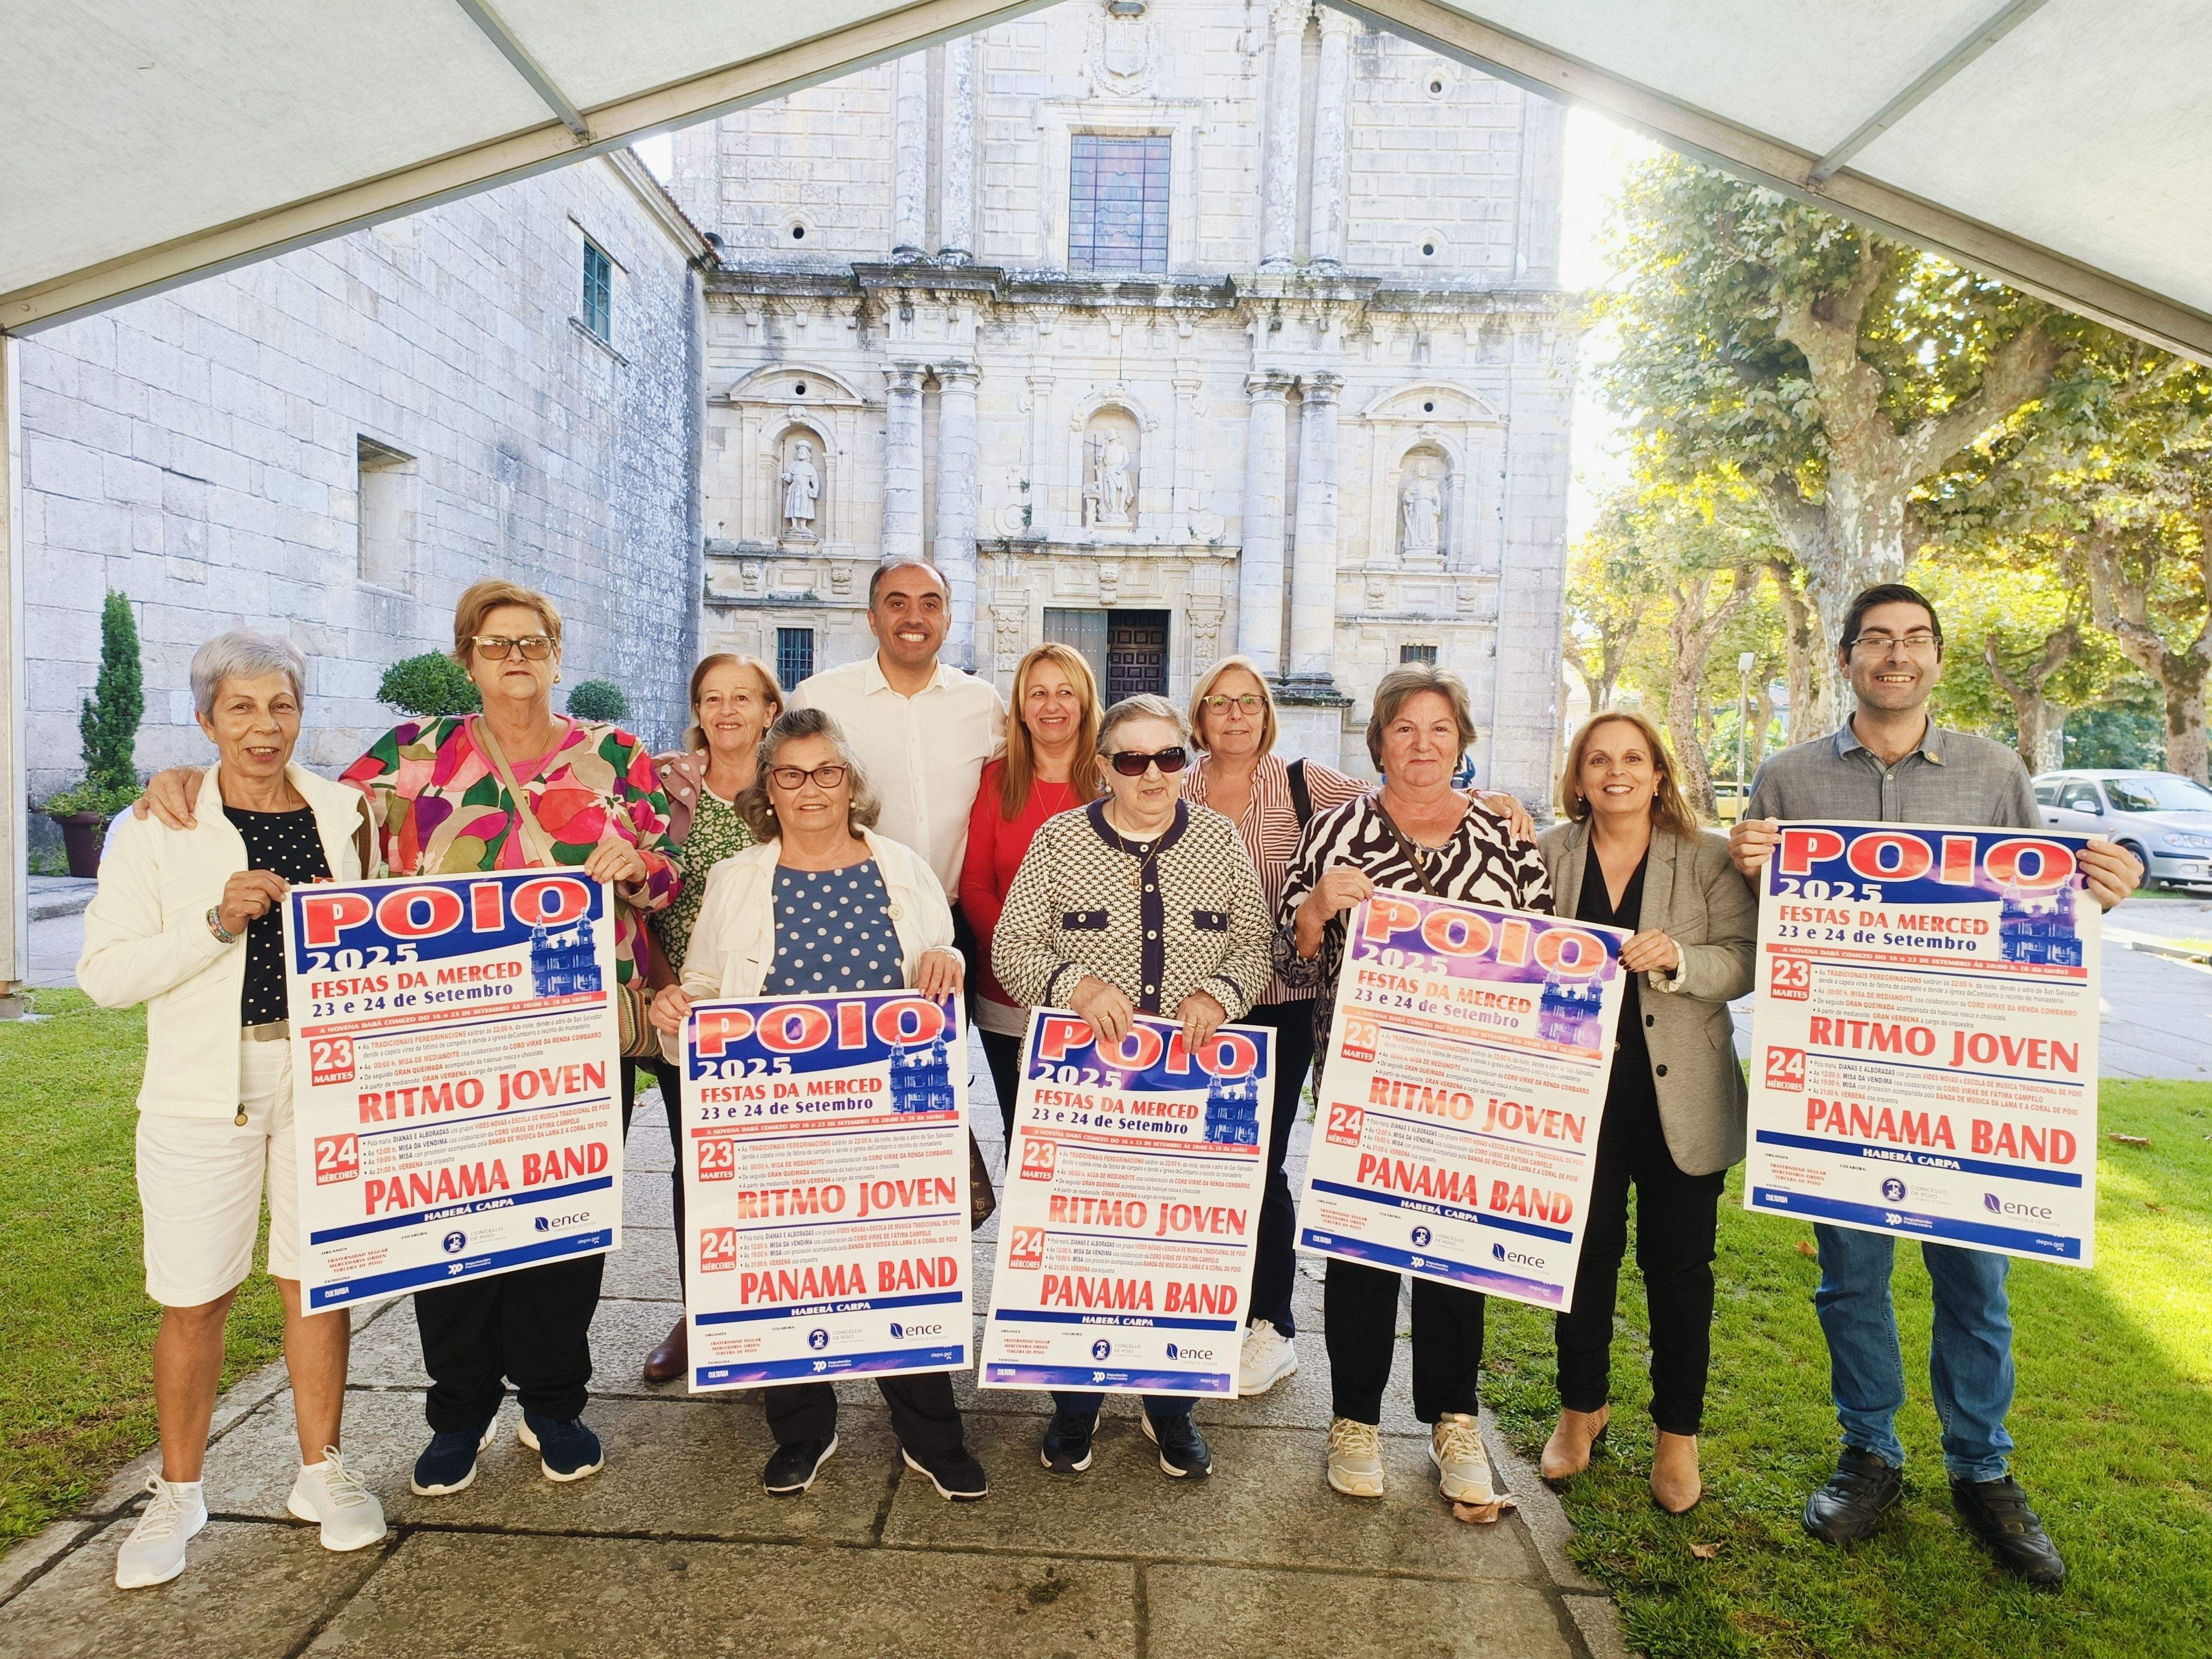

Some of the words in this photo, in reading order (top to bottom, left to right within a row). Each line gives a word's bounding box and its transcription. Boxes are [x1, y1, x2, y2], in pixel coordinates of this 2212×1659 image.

[1778, 827, 2077, 888] POIO
[1777, 877, 1884, 905] 2025
[301, 876, 591, 947] POIO
[1779, 905, 1851, 925] FESTAS
[1859, 911, 1889, 928] DA
[1897, 914, 1989, 935] MERCED
[1362, 895, 1609, 977] POIO
[1778, 925, 1798, 938] 23
[1806, 929, 1817, 939] e
[1825, 928, 1845, 941] 24
[1853, 930, 1876, 943] de
[1883, 933, 1977, 951] Setembro
[305, 942, 420, 975] 2025
[1357, 943, 1451, 978] 2025
[1789, 946, 1818, 955] NOVENA
[1931, 958, 1972, 967] SETEMBRO
[2044, 968, 2068, 976] tarde)
[311, 975, 389, 999] FESTAS
[397, 971, 428, 990] DA
[437, 961, 522, 985] MERCED
[1772, 959, 1811, 987] 23
[312, 1002, 335, 1017] 23
[344, 1002, 355, 1014] e
[364, 996, 386, 1011] 24
[394, 993, 416, 1008] de
[424, 984, 512, 1004] Setembro
[1358, 969, 1419, 994] FESTAS
[1425, 982, 1449, 1000] DA
[1456, 988, 1531, 1014] MERCED
[1771, 988, 1809, 1000] MARTES
[1354, 988, 1373, 1002] 23
[1379, 995, 1388, 1004] e
[1394, 995, 1412, 1009] 24
[1419, 999, 1438, 1014] de
[1443, 1004, 1519, 1028] Setembro
[695, 999, 945, 1057] POIO
[1344, 1021, 1380, 1049] 23
[313, 1037, 353, 1073] 23
[1038, 1016, 1258, 1079] POIO
[1342, 1049, 1374, 1062] MARTES
[1809, 1016, 1936, 1056] RITMO
[1948, 1030, 2079, 1073] JOVEN
[313, 1071, 354, 1084] MARTES
[372, 1071, 393, 1080] seguido
[412, 1063, 443, 1074] QUEIMADA
[696, 1056, 793, 1082] 2025
[1034, 1062, 1124, 1091] 2025
[1767, 1050, 1805, 1078] 24
[359, 1078, 484, 1124] RITMO
[496, 1061, 605, 1110] JOVEN
[701, 1084, 766, 1103] FESTAS
[773, 1083, 799, 1098] DA
[807, 1078, 882, 1096] MERCED
[1766, 1077, 1804, 1093] MÉRCORES
[701, 1107, 720, 1120] 23
[727, 1108, 737, 1118] e
[744, 1104, 763, 1117] 24
[770, 1102, 789, 1115] de
[795, 1097, 873, 1114] Setembro
[1034, 1088, 1094, 1110] FESTAS
[1100, 1097, 1124, 1114] DA
[1130, 1100, 1198, 1120] MERCED
[1368, 1076, 1474, 1120] RITMO
[1481, 1098, 1586, 1144] JOVEN
[1031, 1108, 1049, 1121] 23
[1056, 1112, 1064, 1122] e
[1070, 1112, 1088, 1125] 24
[1094, 1115, 1112, 1128] de
[1118, 1118, 1188, 1134] Setembro
[1328, 1107, 1363, 1135] 24
[1806, 1097, 1955, 1150] PANAMA
[1971, 1119, 2076, 1165] BAND
[317, 1137, 359, 1170] 24
[1326, 1131, 1359, 1148] MÉRCORES
[699, 1139, 733, 1170] 23
[1023, 1141, 1057, 1168] 23
[1863, 1148, 1914, 1163] HABERÁ
[1917, 1156, 1960, 1170] CARPA
[317, 1166, 359, 1184] MÉRCORES
[365, 1158, 510, 1215] PANAMA
[523, 1142, 608, 1186] BAND
[699, 1170, 734, 1179] MARTES
[1021, 1170, 1053, 1181] MARTES
[1357, 1153, 1478, 1206] PANAMA
[1489, 1179, 1573, 1224] BAND
[424, 1203, 473, 1222] HABERÁ
[476, 1198, 514, 1212] CARPA
[738, 1185, 846, 1219] RITMO
[857, 1176, 956, 1218] JOVEN
[1400, 1200, 1441, 1215] HABERÁ
[1444, 1209, 1478, 1223] CARPA
[2004, 1202, 2052, 1219] ence
[551, 1212, 590, 1228] ence
[1049, 1195, 1148, 1229] RITMO
[1155, 1203, 1246, 1236] JOVEN
[702, 1230, 736, 1259] 24
[1011, 1230, 1043, 1257] 24
[1435, 1233, 1465, 1243] CONCELLO
[2035, 1239, 2065, 1250] depo.gal
[701, 1258, 736, 1271] MÉRCORES
[1009, 1257, 1041, 1270] MÉRCORES
[1507, 1252, 1545, 1269] ence
[741, 1263, 867, 1304] PANAMA
[878, 1256, 957, 1291] BAND
[1040, 1274, 1154, 1311] PANAMA
[1163, 1281, 1237, 1314] BAND
[791, 1303, 834, 1316] HABERÁ
[837, 1302, 871, 1312] CARPA
[1082, 1316, 1120, 1325] HABERÁ
[1123, 1318, 1154, 1327] CARPA
[906, 1324, 942, 1336] ence
[1179, 1349, 1213, 1360] ence
